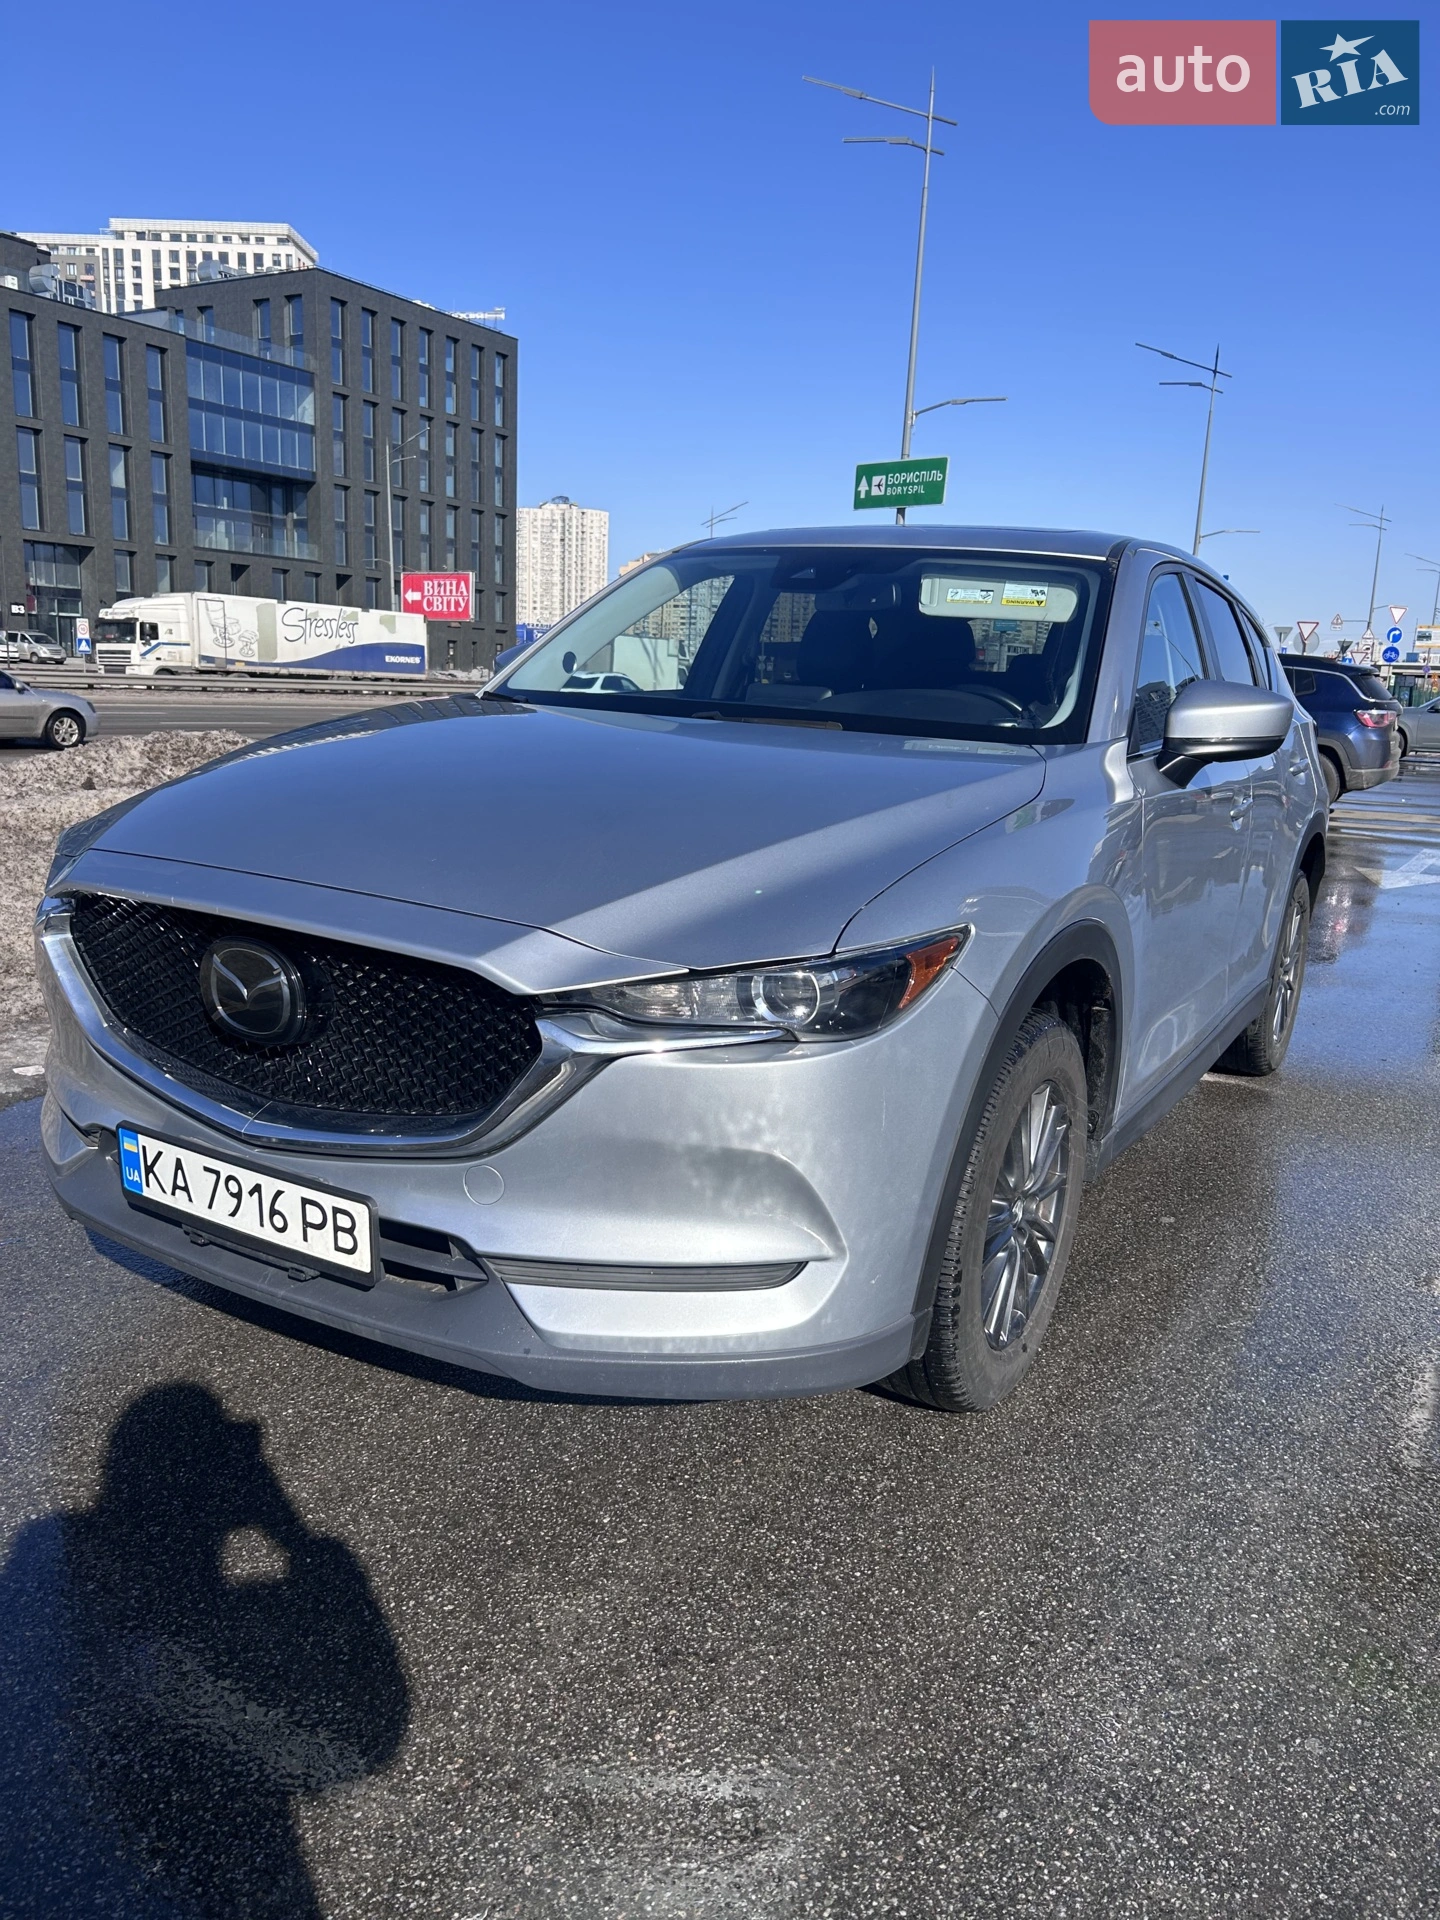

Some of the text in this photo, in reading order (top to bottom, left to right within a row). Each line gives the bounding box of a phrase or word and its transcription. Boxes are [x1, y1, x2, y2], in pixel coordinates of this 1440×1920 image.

[887, 470, 943, 485] БОРИСПІЛЬ
[886, 485, 925, 496] BORYSPIL
[423, 580, 469, 596] ВИНА
[422, 596, 469, 612] СВІТУ
[282, 607, 359, 645] Stressless
[385, 655, 421, 664] EKORNES
[126, 1166, 141, 1184] UA
[141, 1145, 359, 1256] KA 7916 PB
